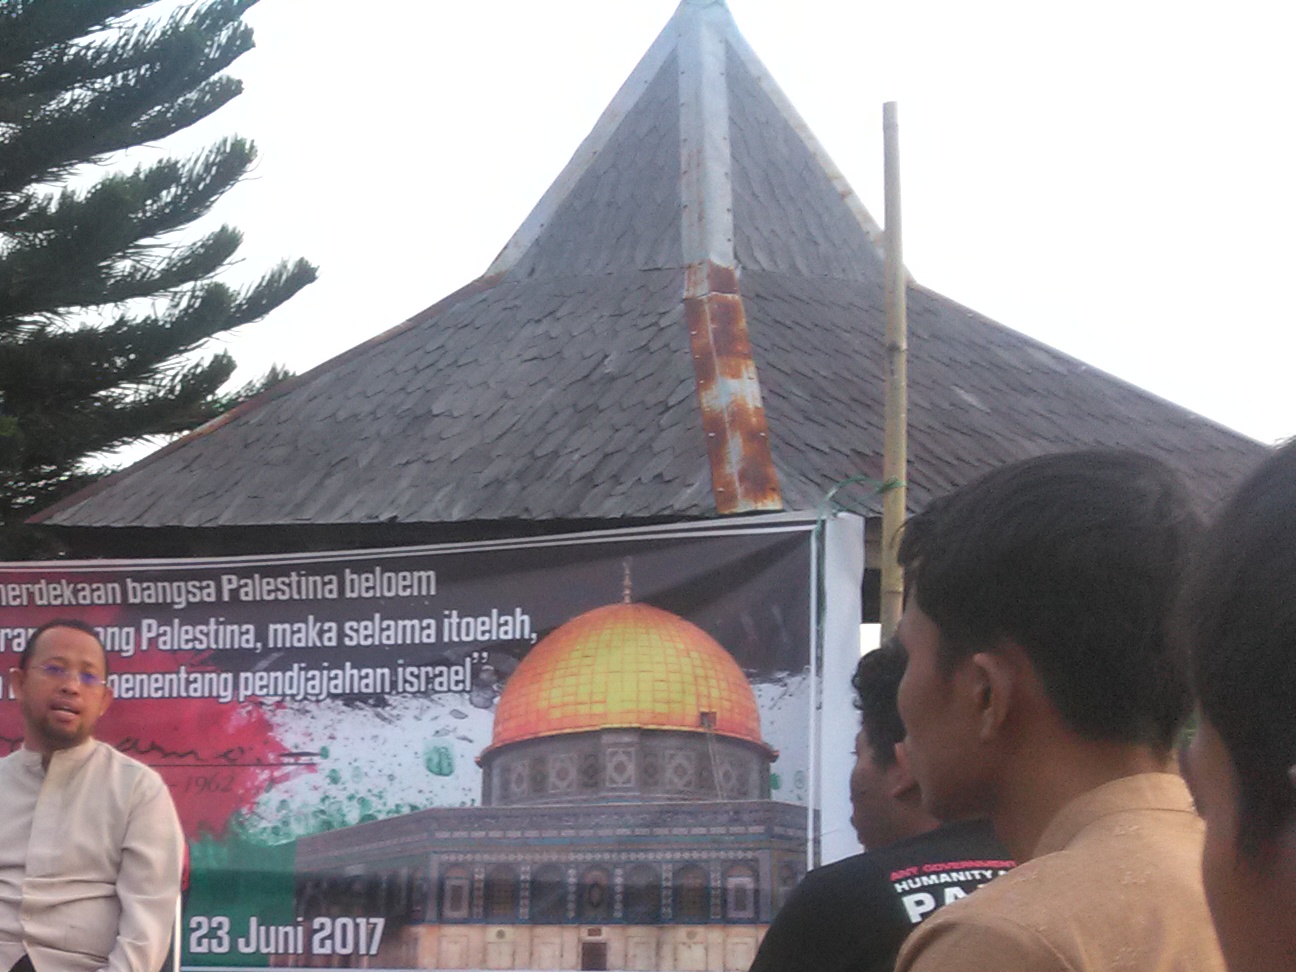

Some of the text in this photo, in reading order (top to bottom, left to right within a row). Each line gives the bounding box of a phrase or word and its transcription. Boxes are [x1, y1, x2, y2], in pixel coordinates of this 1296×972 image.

[126, 576, 217, 608] bangsa
[221, 571, 339, 601] Palestina
[344, 566, 437, 599] beloem
[141, 616, 262, 653] Palestina,
[267, 615, 338, 648] maka
[343, 612, 437, 646] selama
[442, 607, 538, 644] itoelah,
[239, 661, 390, 702] pendjajahan
[894, 870, 992, 892] HUMANITY
[189, 916, 386, 956] 23 Juni 2017
